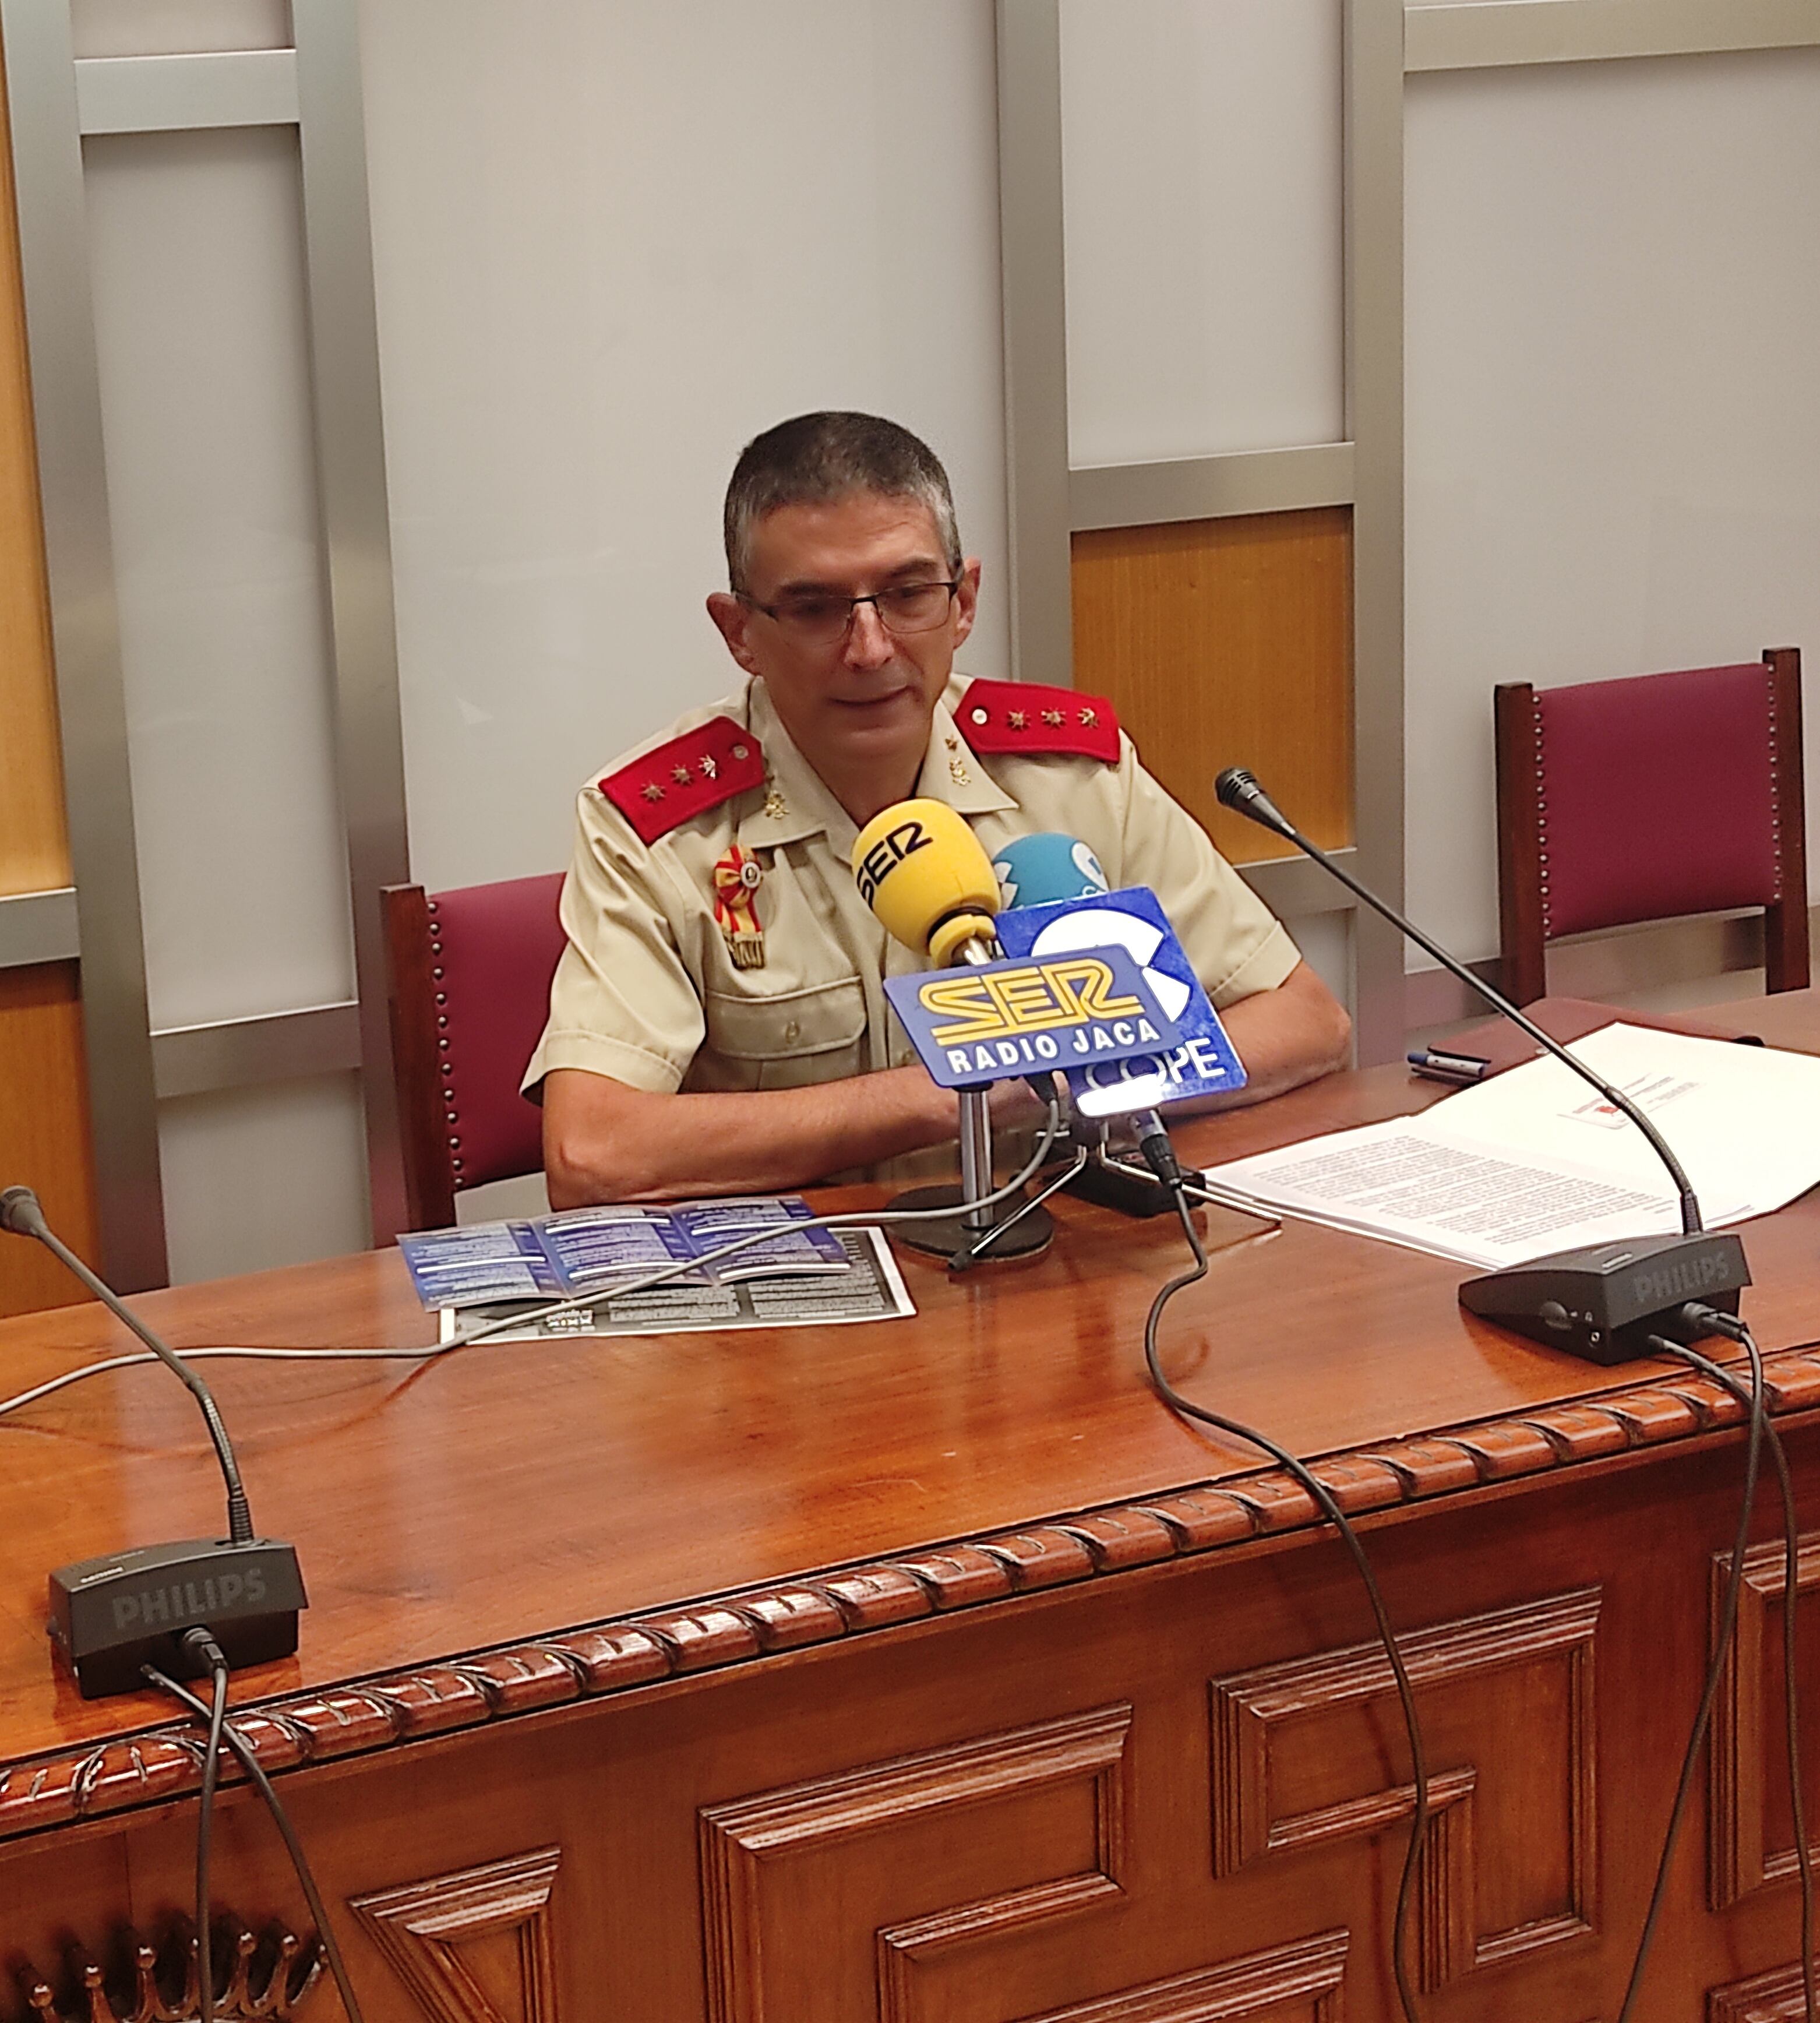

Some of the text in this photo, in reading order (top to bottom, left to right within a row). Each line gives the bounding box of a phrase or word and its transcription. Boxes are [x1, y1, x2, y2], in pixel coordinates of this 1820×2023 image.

[856, 822, 934, 911] SER
[919, 957, 1147, 1047] SER
[946, 1018, 1161, 1074] RADIO JACA
[1633, 1252, 1730, 1303] PHILIPS
[111, 1567, 267, 1630] PHILIPS
